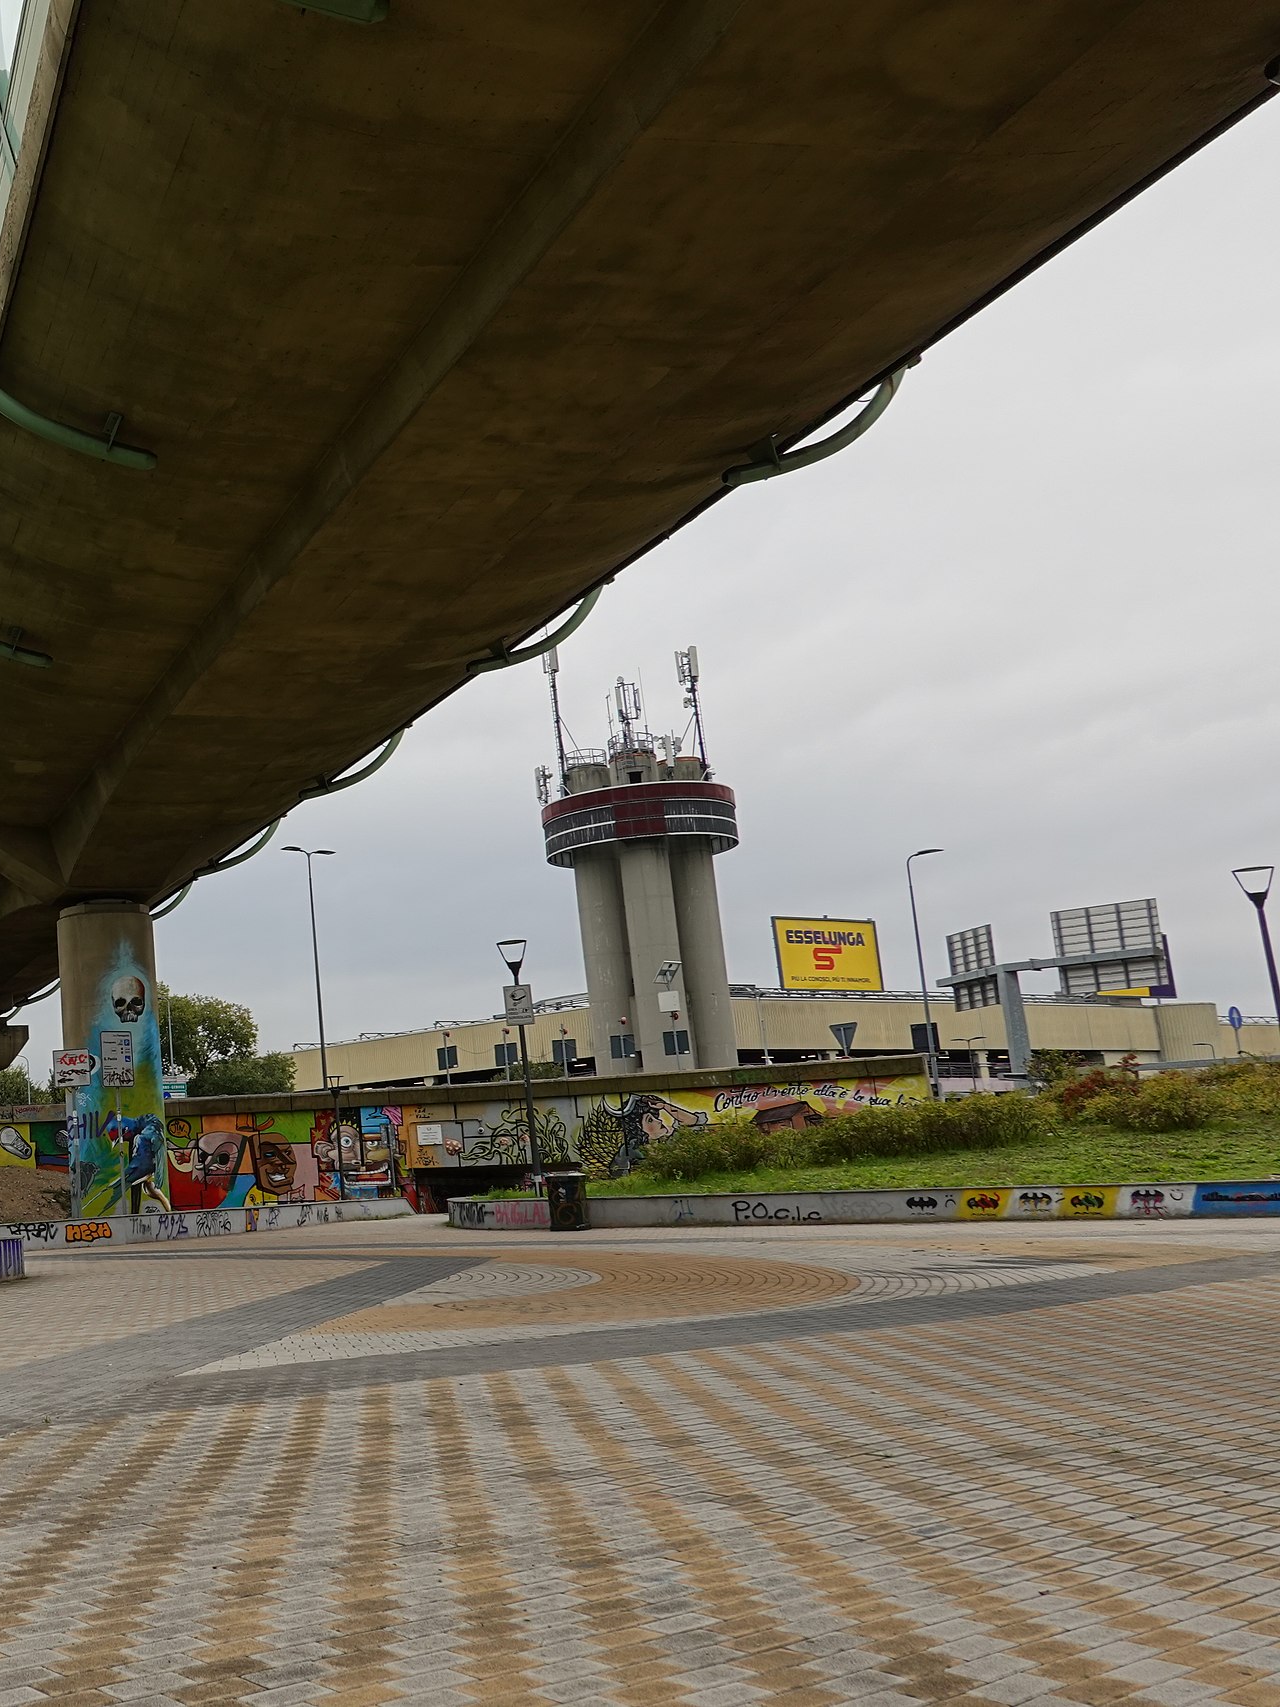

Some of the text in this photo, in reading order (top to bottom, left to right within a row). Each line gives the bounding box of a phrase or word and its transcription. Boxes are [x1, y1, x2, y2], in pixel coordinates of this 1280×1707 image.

[785, 930, 866, 946] ESSELUNGA
[713, 1087, 761, 1113] Contro
[772, 1082, 812, 1098] vento
[852, 1089, 865, 1102] la
